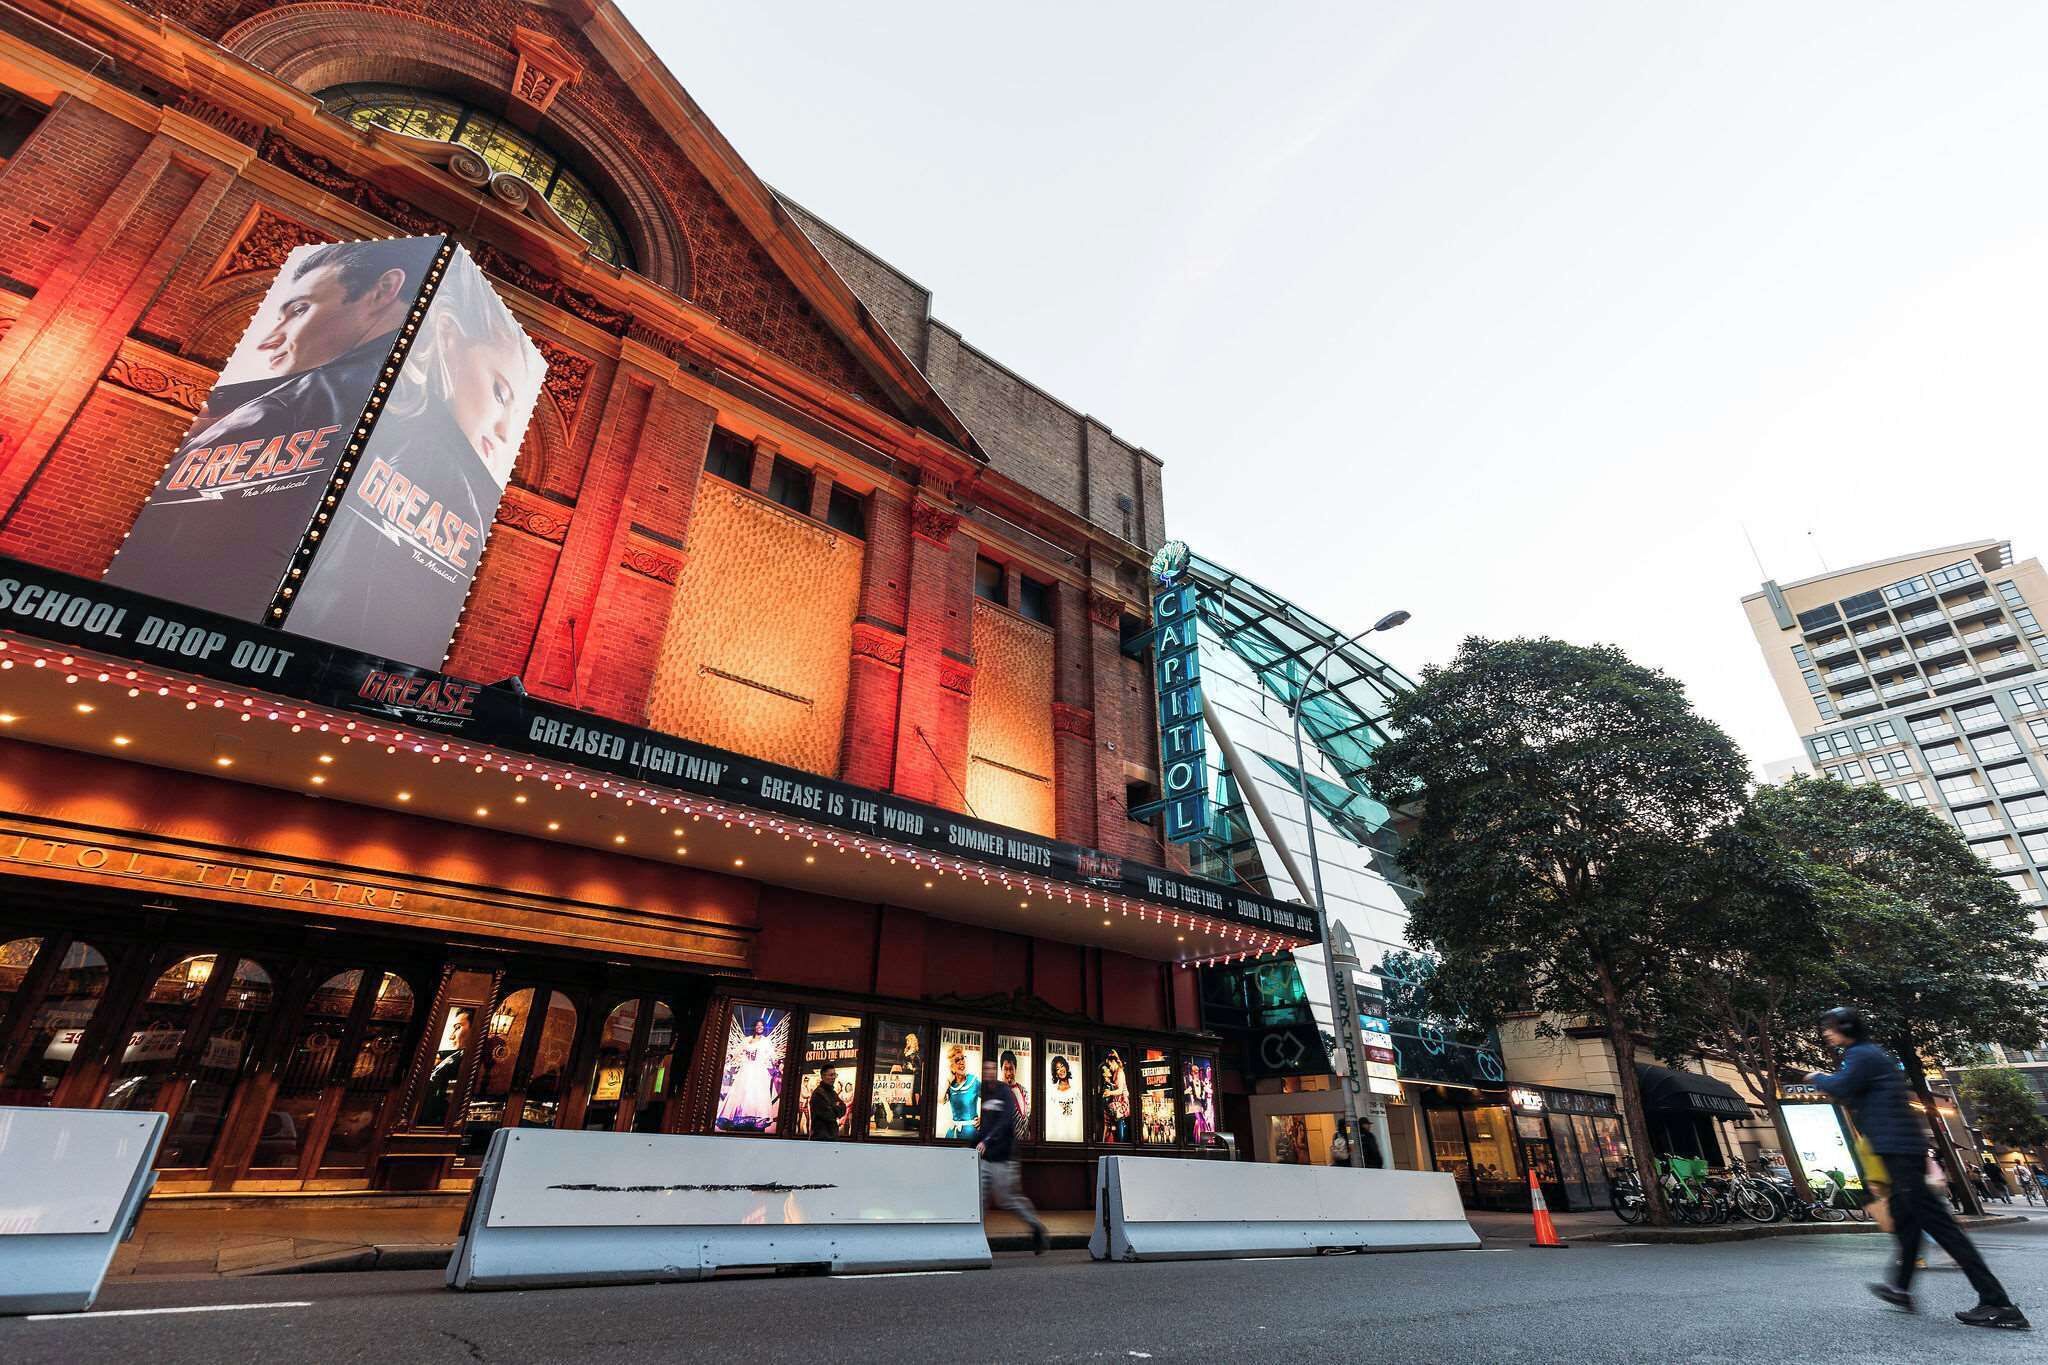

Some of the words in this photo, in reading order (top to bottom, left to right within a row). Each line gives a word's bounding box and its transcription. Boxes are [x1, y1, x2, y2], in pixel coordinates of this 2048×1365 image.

[166, 424, 342, 490] GREASE
[241, 488, 259, 498] The
[262, 475, 311, 494] Musical
[357, 457, 479, 569] GREASE
[411, 548, 426, 564] The
[425, 560, 458, 584] Musical
[0, 578, 128, 638] SCHOOL
[135, 614, 227, 660] DROP
[231, 640, 295, 678] OUT
[358, 670, 480, 716] GREASE
[1158, 592, 1193, 830] CAPITOL
[415, 714, 429, 723] The
[431, 716, 464, 728] Musical
[529, 715, 626, 761] GREASED
[629, 742, 729, 785] LIGHTNIN'
[760, 775, 823, 811] GREASE
[827, 792, 844, 817] IS
[851, 799, 877, 824] THE
[883, 806, 925, 836] WORD
[949, 824, 1004, 856] SUMMER
[1007, 840, 1051, 867] NIGHTS
[194, 862, 409, 910] THEATRE
[1147, 875, 1163, 895] WE
[1165, 880, 1177, 899] GO
[1179, 883, 1223, 911] TOGETHER
[1237, 899, 1260, 920] BORN
[1261, 904, 1272, 923] TO
[1272, 908, 1295, 928] HAND
[1296, 914, 1314, 933] JIVE
[1335, 970, 1351, 1028] SQUARE
[805, 1051, 827, 1061] (STILL)
[828, 1050, 839, 1060] THE
[825, 1039, 847, 1050] GREASE
[847, 1039, 854, 1049] IS
